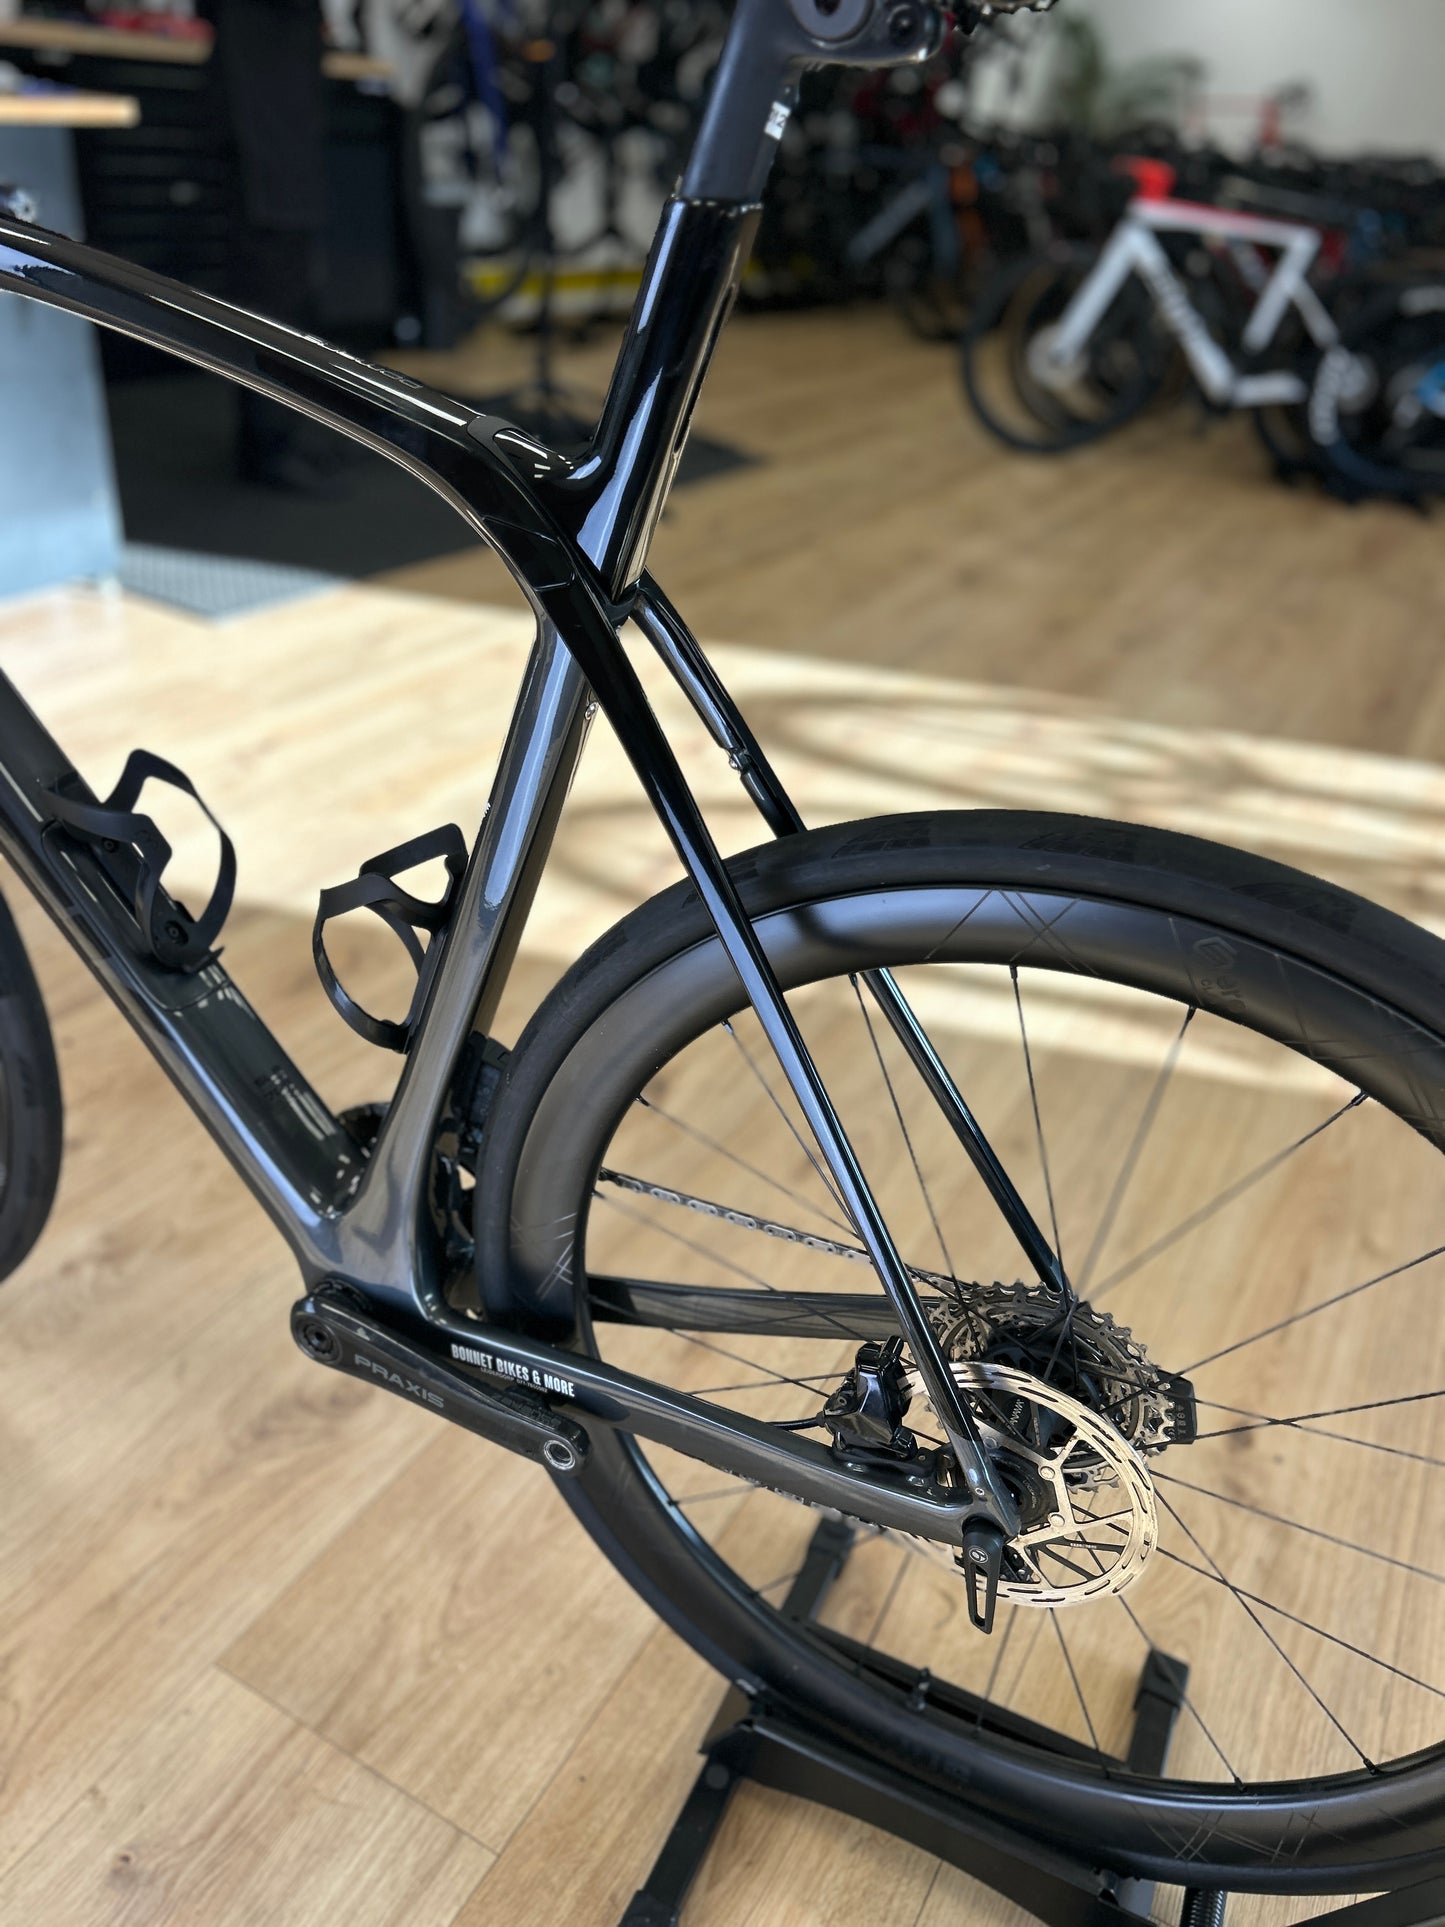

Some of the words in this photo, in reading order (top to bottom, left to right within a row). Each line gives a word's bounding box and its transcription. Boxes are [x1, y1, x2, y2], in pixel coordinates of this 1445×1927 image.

[354, 1353, 444, 1409] PRAXIS
[450, 1343, 493, 1370] BONNET
[496, 1357, 530, 1383] BIKES
[531, 1369, 541, 1386] &
[543, 1373, 576, 1398] MORE
